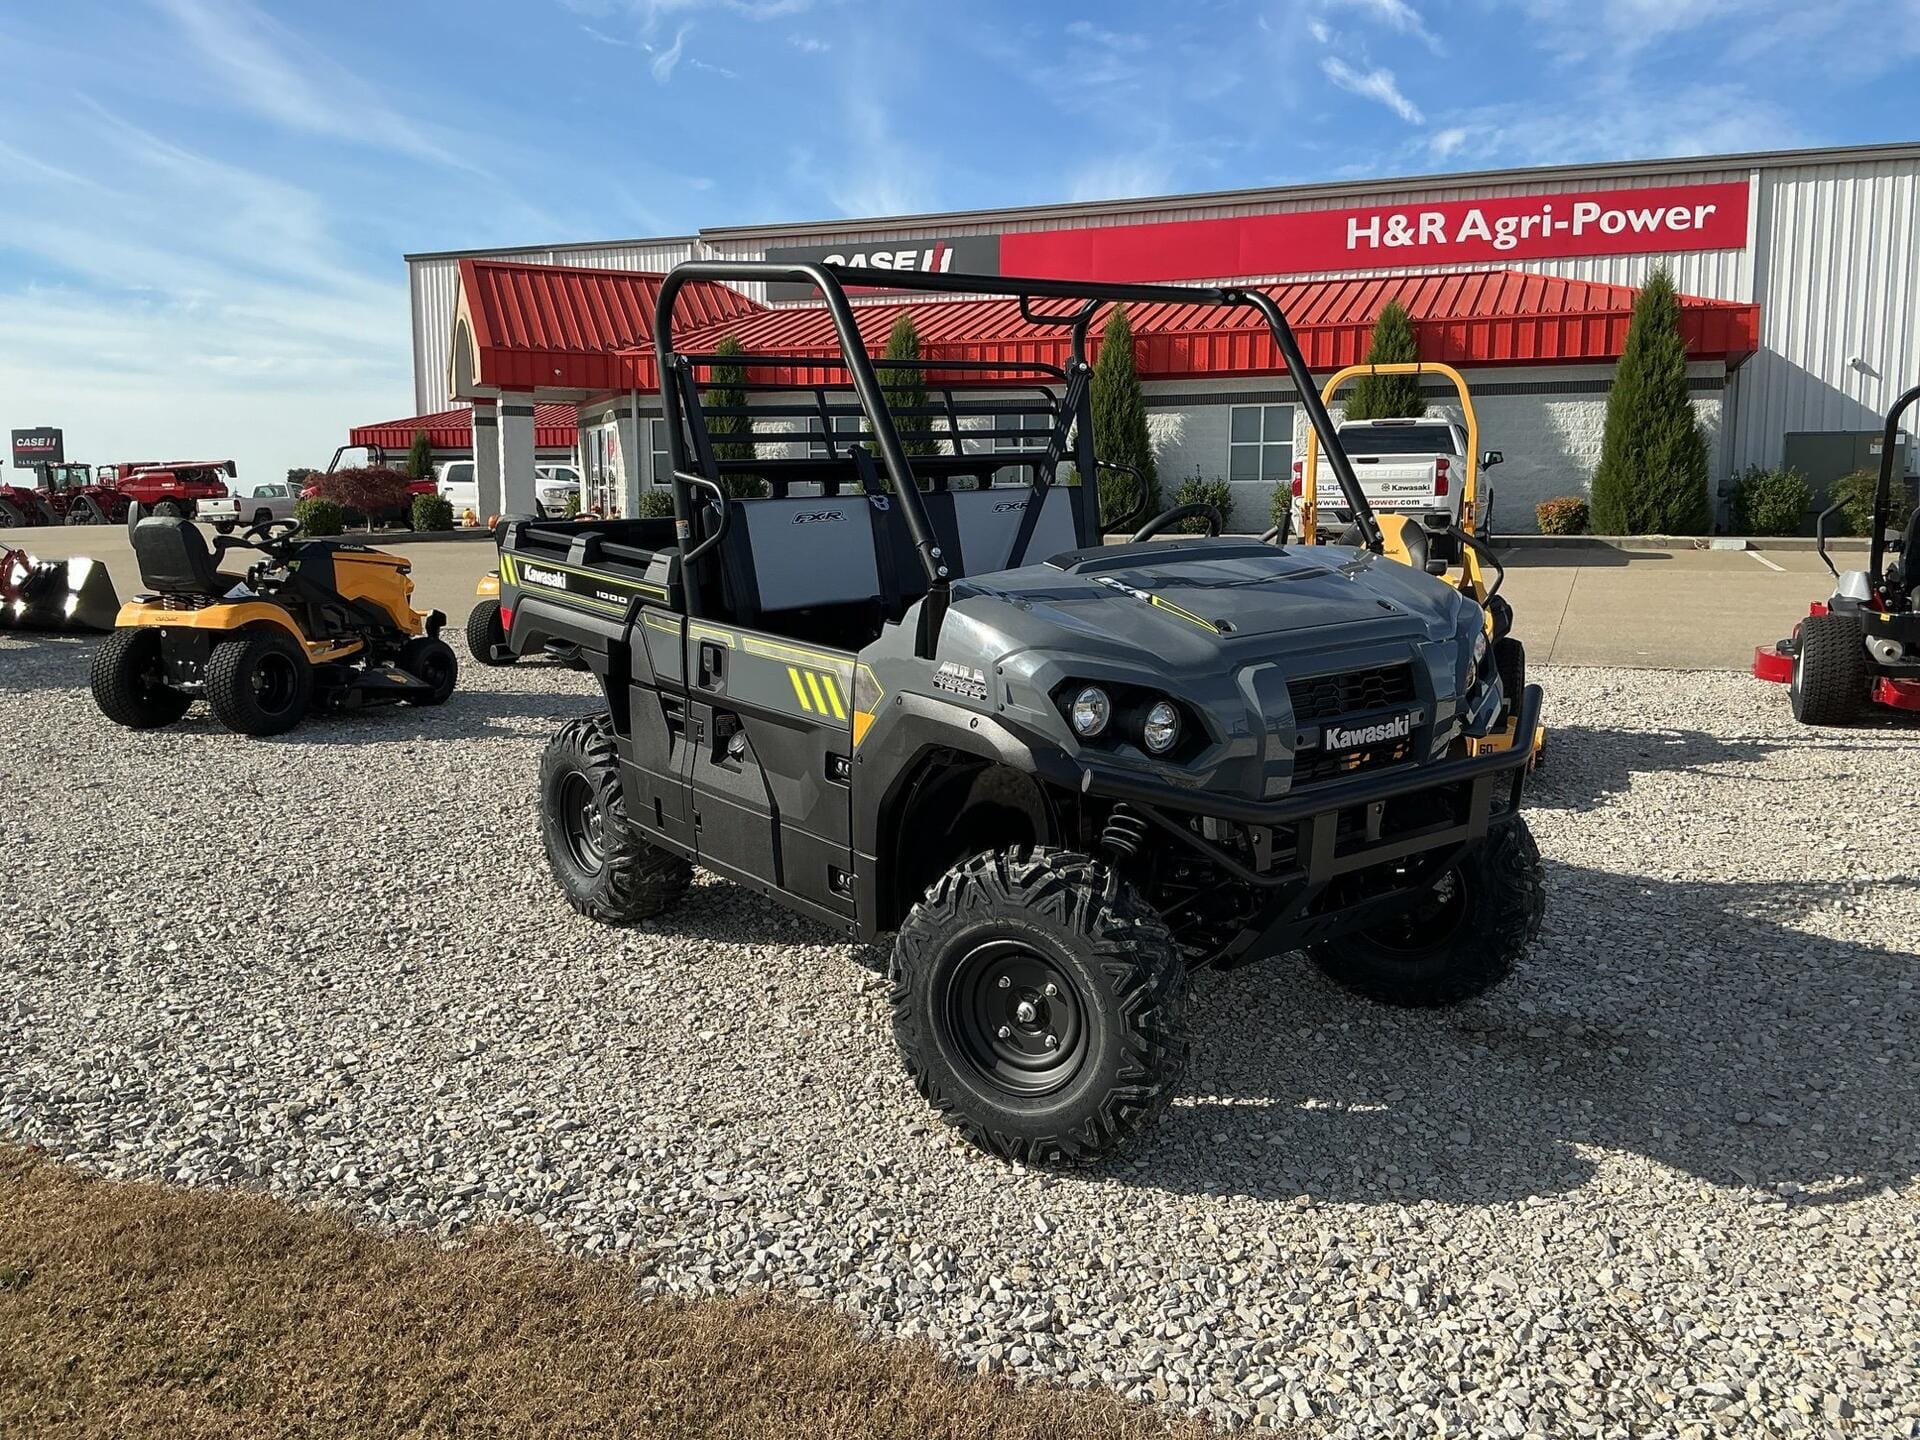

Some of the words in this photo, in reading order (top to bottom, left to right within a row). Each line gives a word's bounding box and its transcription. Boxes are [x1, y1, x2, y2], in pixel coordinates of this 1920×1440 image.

[1346, 212, 1447, 250] H&R
[1456, 201, 1716, 251] Agri-Power
[16, 437, 45, 447] CASE
[1391, 483, 1431, 492] Kawasaki
[792, 510, 847, 524] FXR
[524, 563, 567, 590] Kawasaki
[595, 590, 628, 604] 1000
[1326, 714, 1410, 751] Kawasaki
